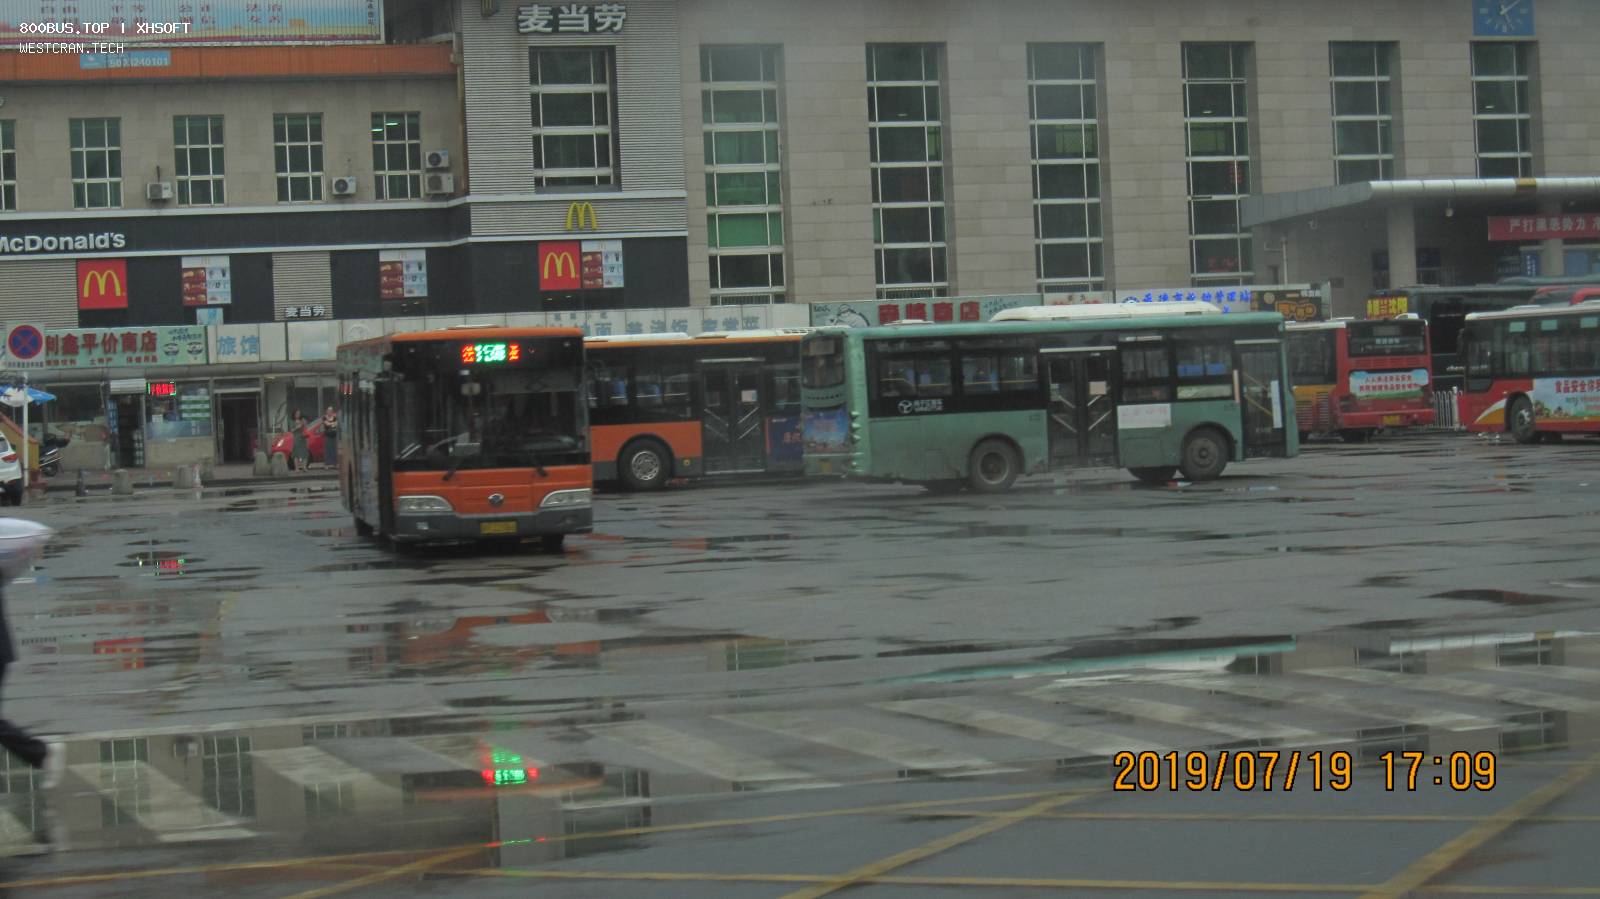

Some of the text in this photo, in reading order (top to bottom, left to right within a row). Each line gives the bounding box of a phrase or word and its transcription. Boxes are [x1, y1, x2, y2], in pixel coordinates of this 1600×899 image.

[518, 4, 626, 33] 麦当劳
[0, 232, 126, 252] McDonald's
[285, 304, 326, 318] 麦当劳
[217, 335, 260, 356] 旅馆
